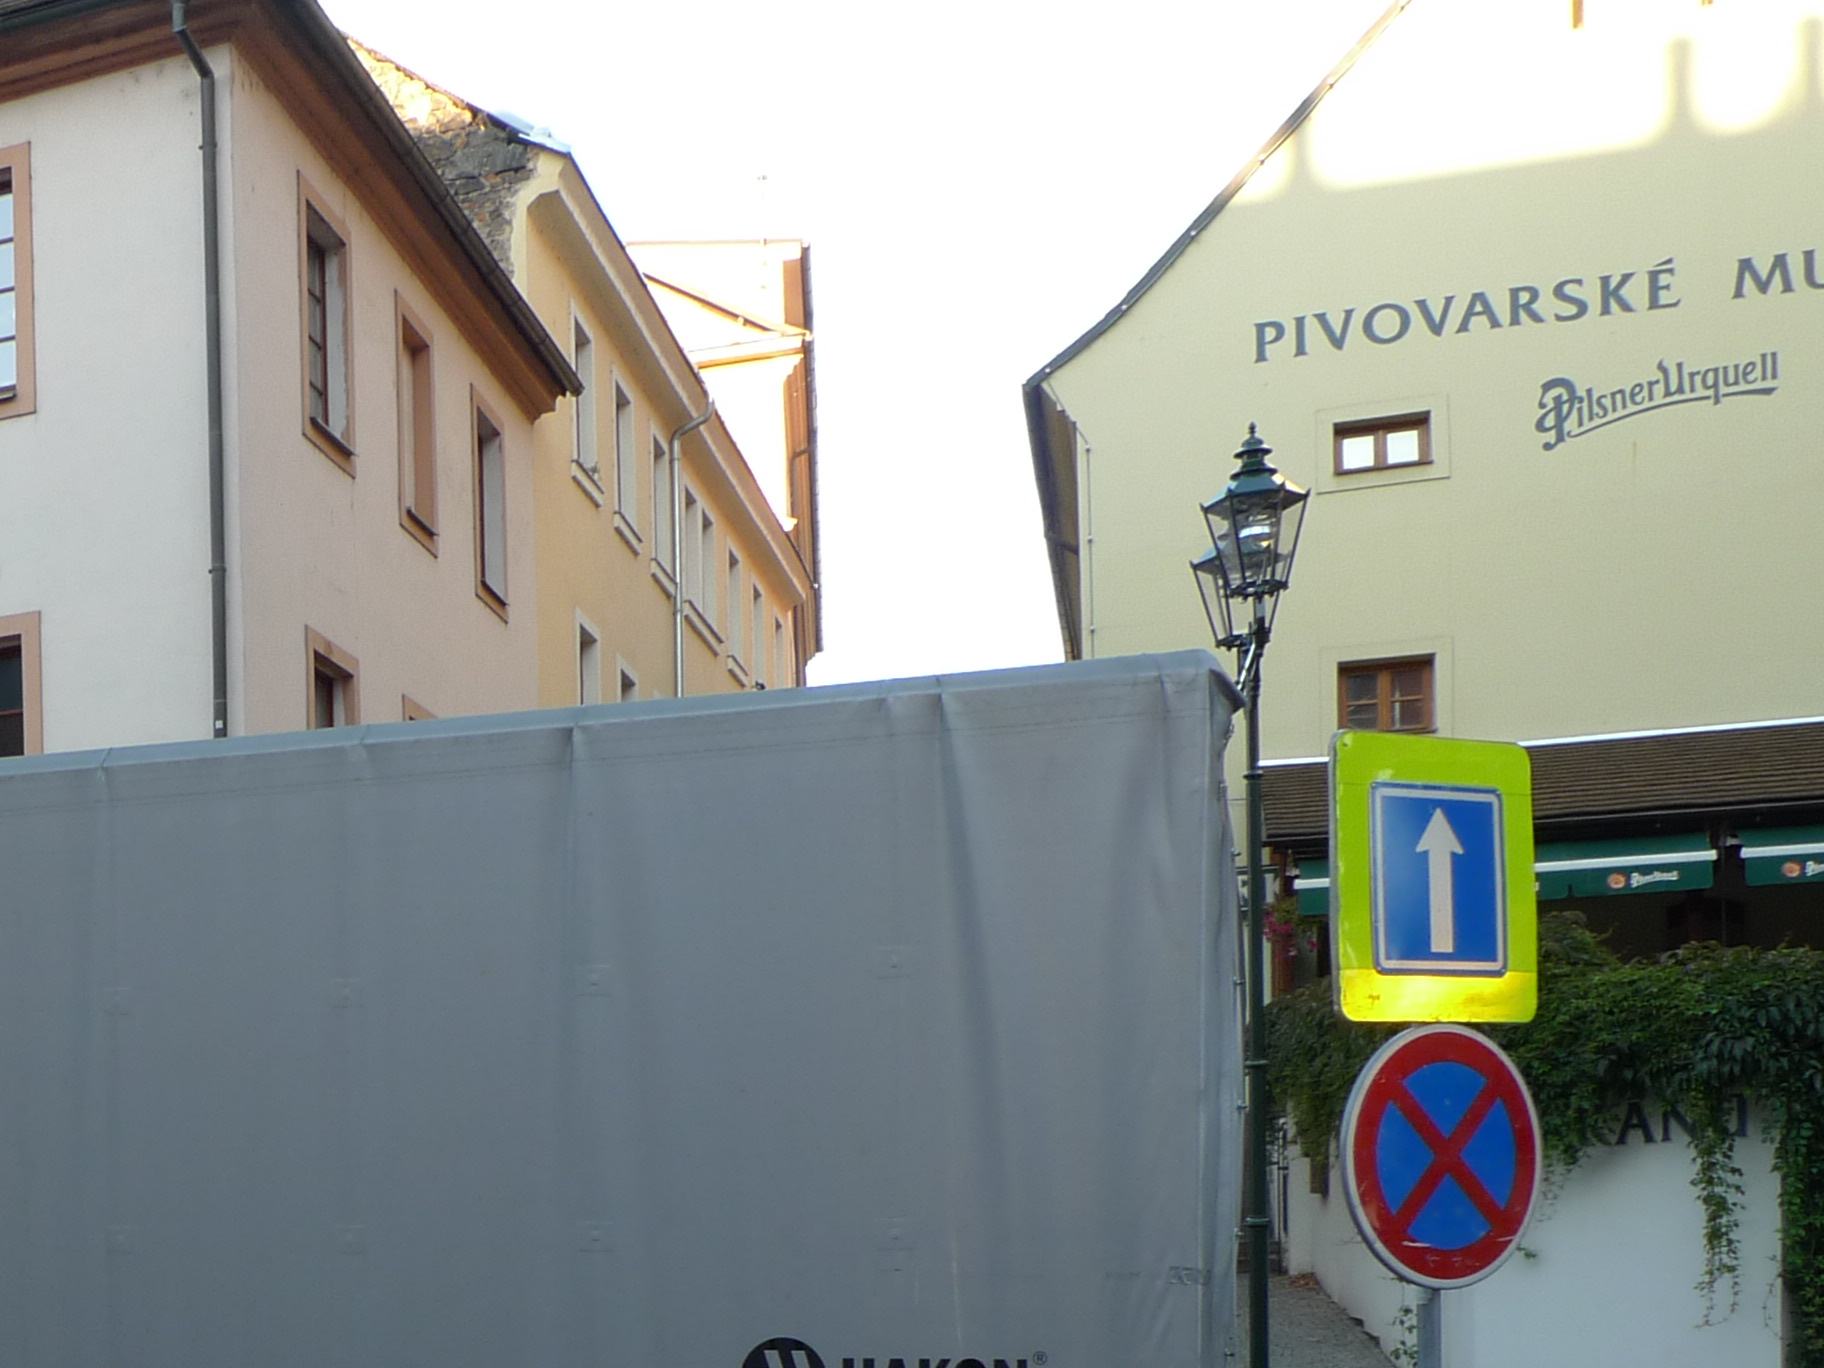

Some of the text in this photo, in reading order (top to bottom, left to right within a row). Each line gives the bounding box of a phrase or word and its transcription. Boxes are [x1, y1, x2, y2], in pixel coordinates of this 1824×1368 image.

[1253, 257, 1681, 363] PIVOVARSKÉ
[1535, 351, 1777, 450] Pilsner Urquell
